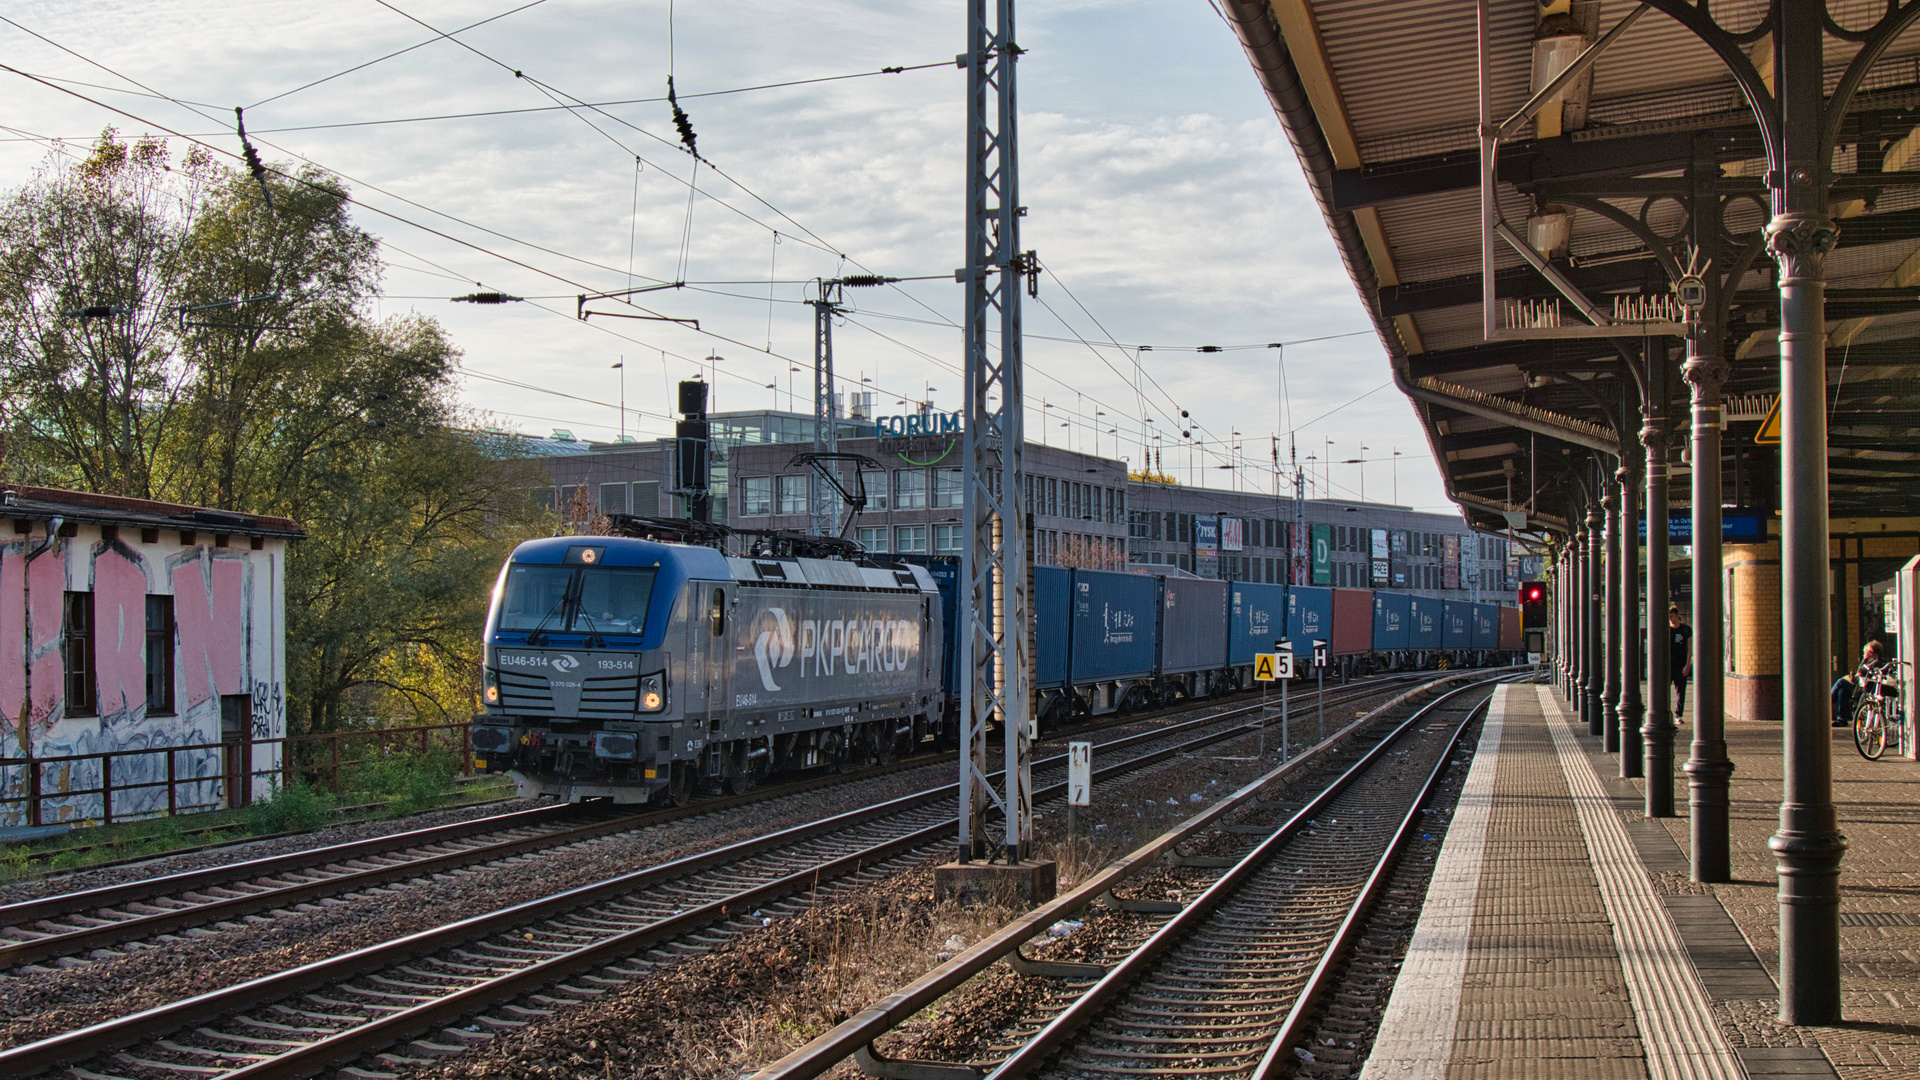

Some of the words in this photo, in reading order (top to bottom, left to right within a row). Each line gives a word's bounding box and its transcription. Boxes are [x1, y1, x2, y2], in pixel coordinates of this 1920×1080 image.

[876, 411, 959, 438] FORUM
[1201, 526, 1216, 538] JYSK
[1317, 539, 1327, 564] D
[500, 655, 548, 667] EU46-514
[597, 660, 633, 670] 193-514
[1279, 656, 1288, 674] 5
[1314, 648, 1327, 667] H
[1256, 656, 1273, 678] A
[1071, 745, 1088, 763] 11
